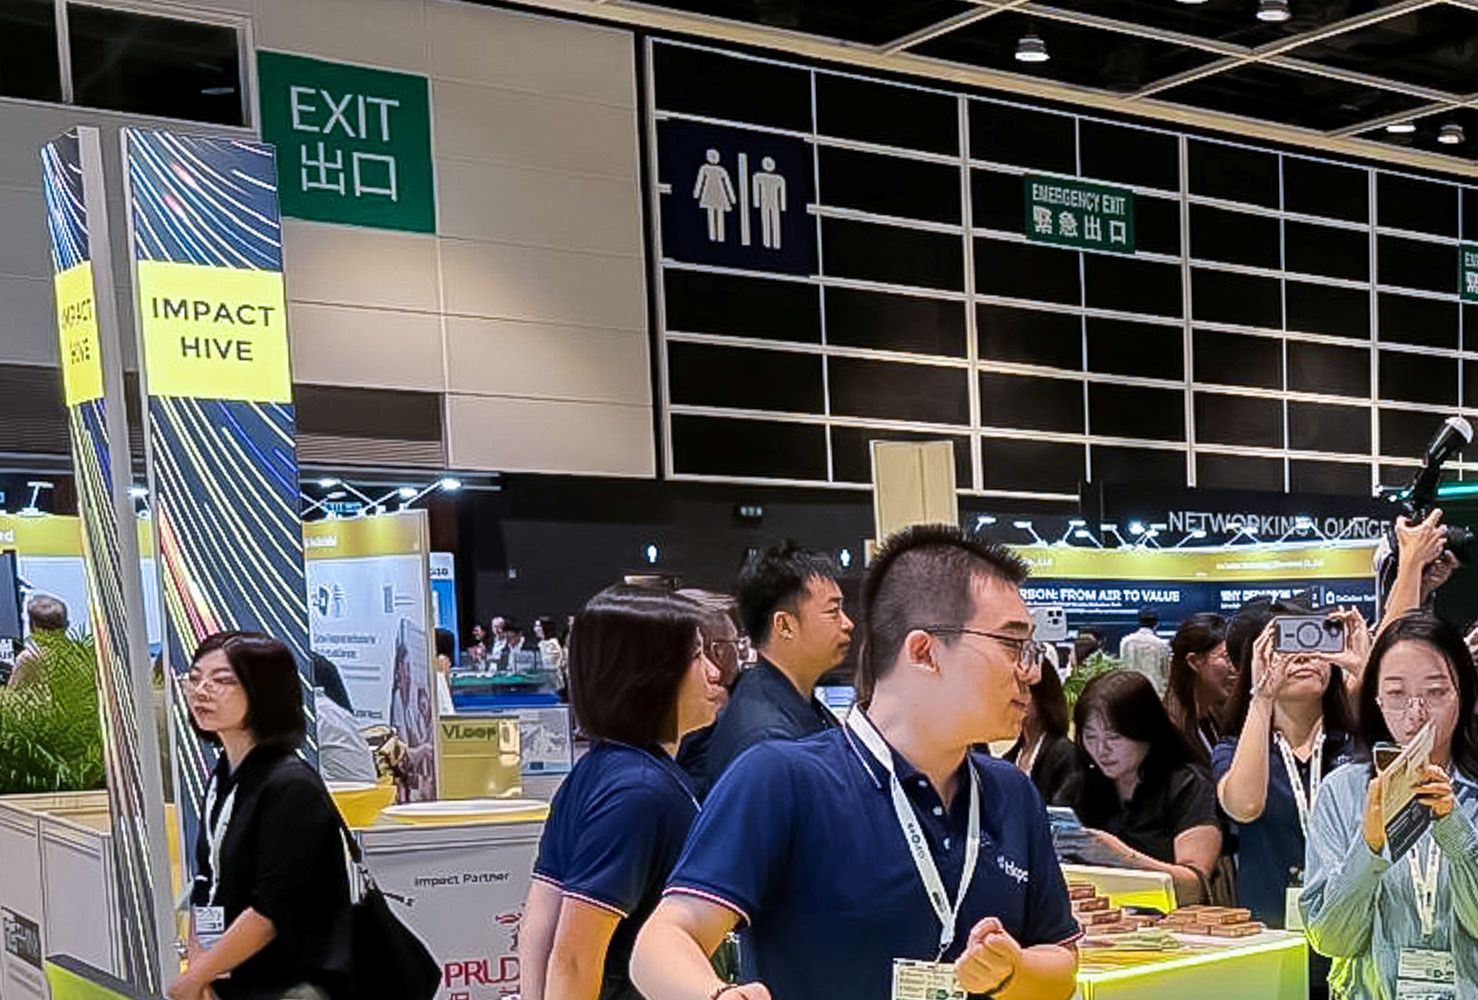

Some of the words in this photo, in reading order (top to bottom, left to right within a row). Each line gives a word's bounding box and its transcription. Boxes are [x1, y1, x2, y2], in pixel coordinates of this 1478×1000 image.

[291, 86, 399, 141] EXIT
[301, 143, 397, 201] 出口
[1102, 194, 1125, 215] EXIT
[1033, 205, 1126, 245] 緊急出口
[152, 297, 276, 327] IMPACT
[181, 336, 254, 361] HIVE
[1060, 588, 1096, 602] FROM
[1098, 590, 1121, 602] AIR
[1123, 589, 1140, 602] TO
[1141, 590, 1180, 602] VALUE
[415, 875, 459, 887] Impact
[463, 872, 509, 884] Partner
